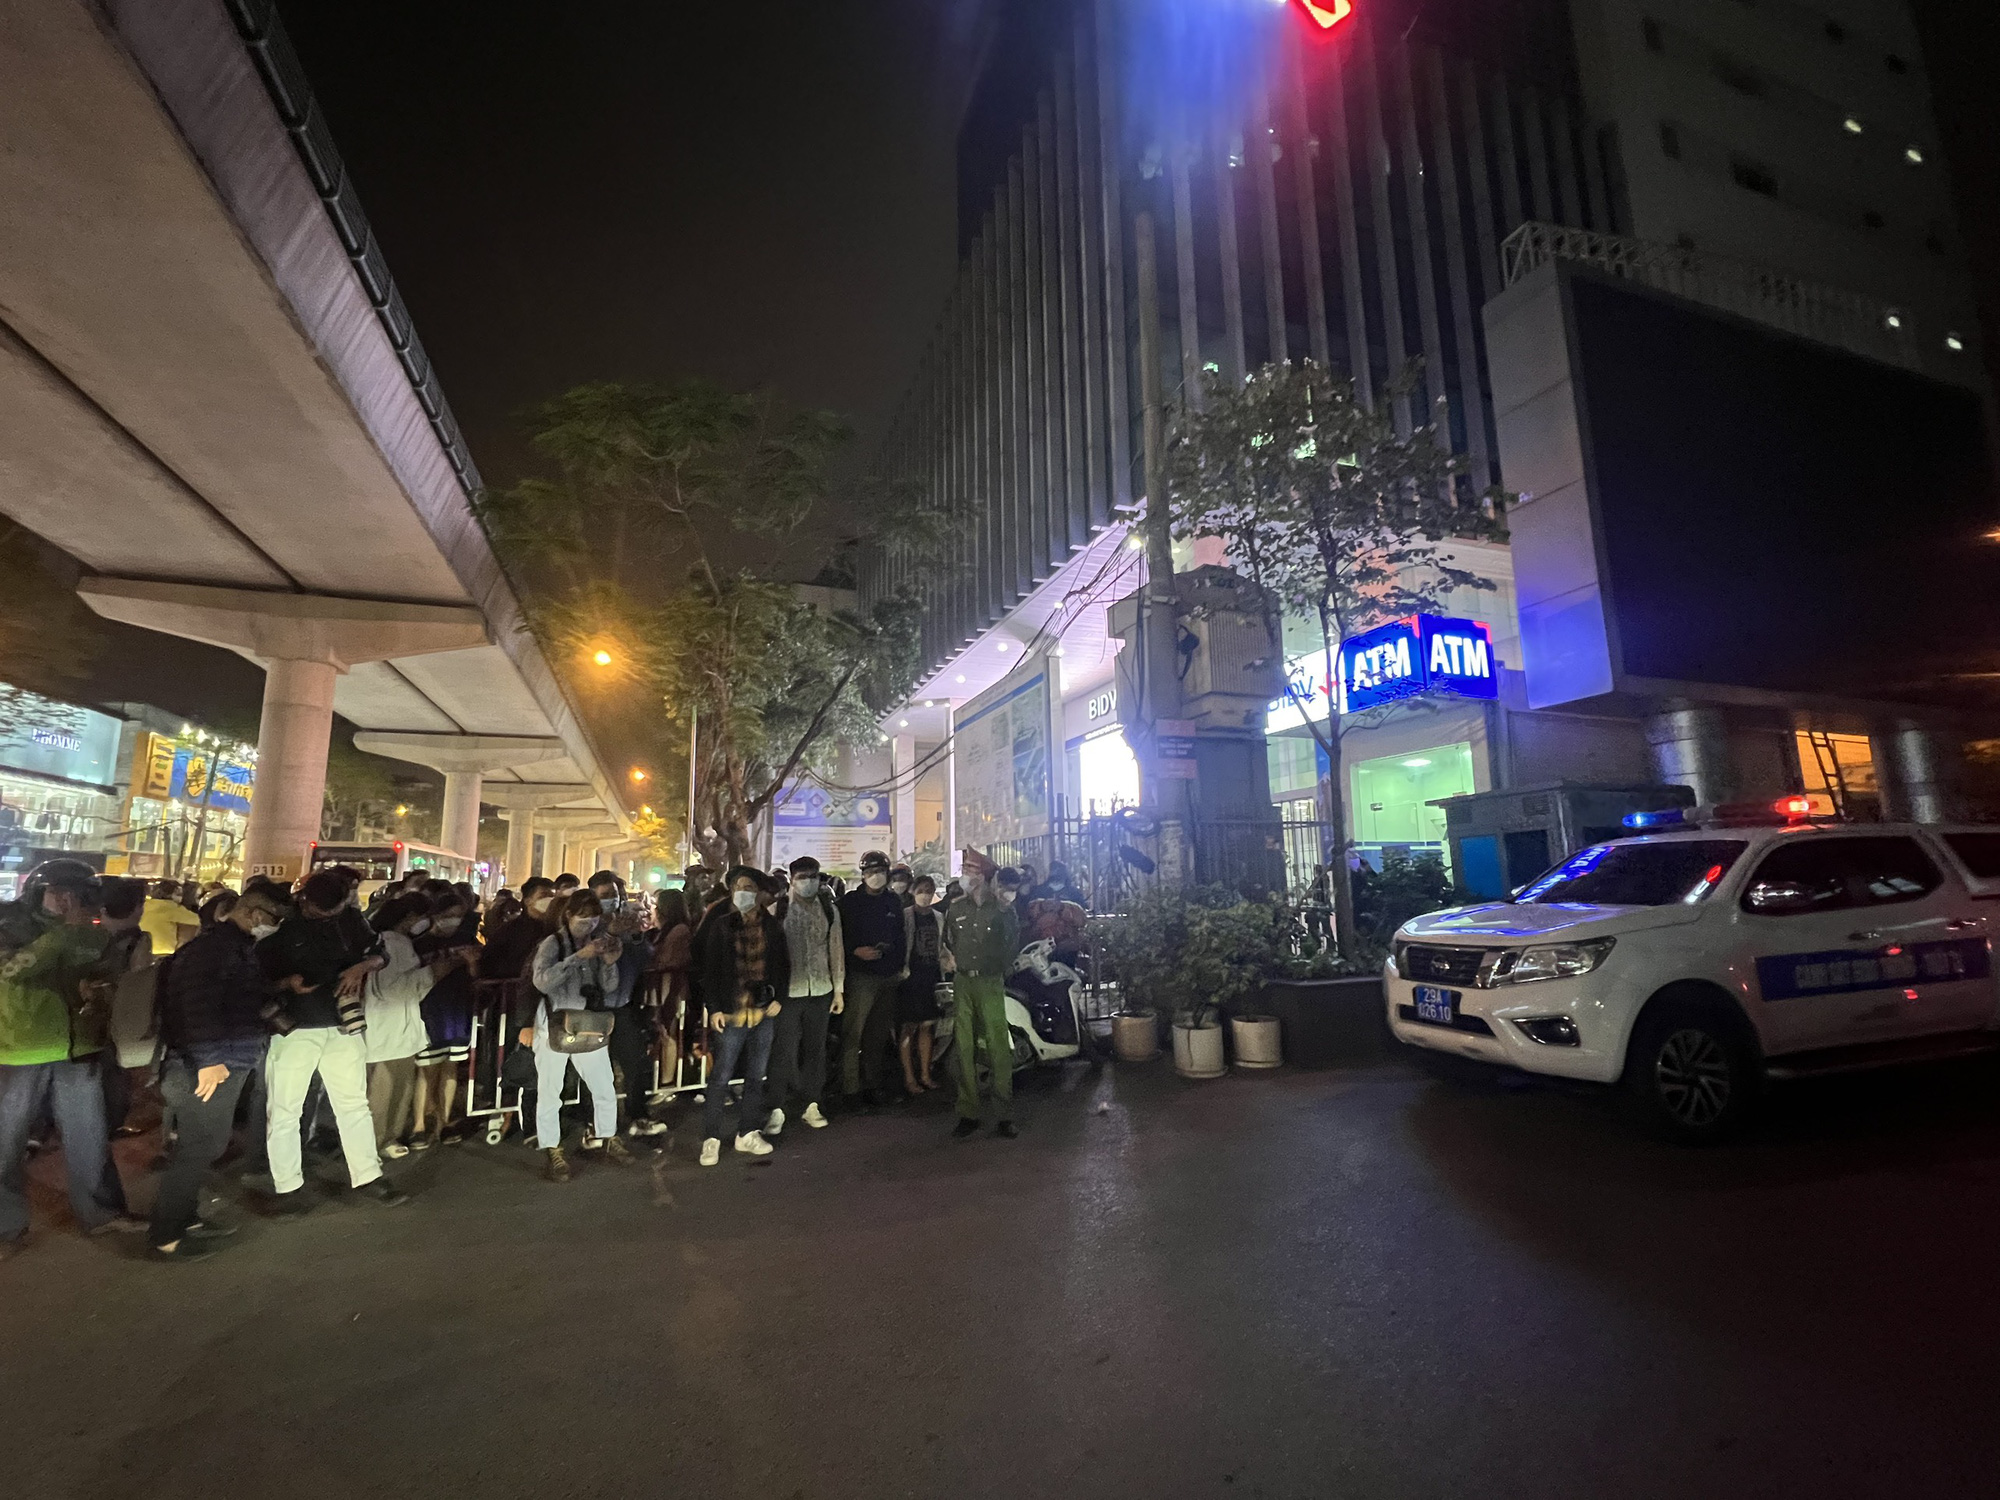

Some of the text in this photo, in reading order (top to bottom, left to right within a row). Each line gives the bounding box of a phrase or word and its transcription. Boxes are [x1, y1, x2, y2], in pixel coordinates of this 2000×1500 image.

[1353, 636, 1412, 692] ATM
[1430, 633, 1490, 679] ATM
[1088, 688, 1117, 720] BIDV
[1423, 987, 1443, 1004] 29A
